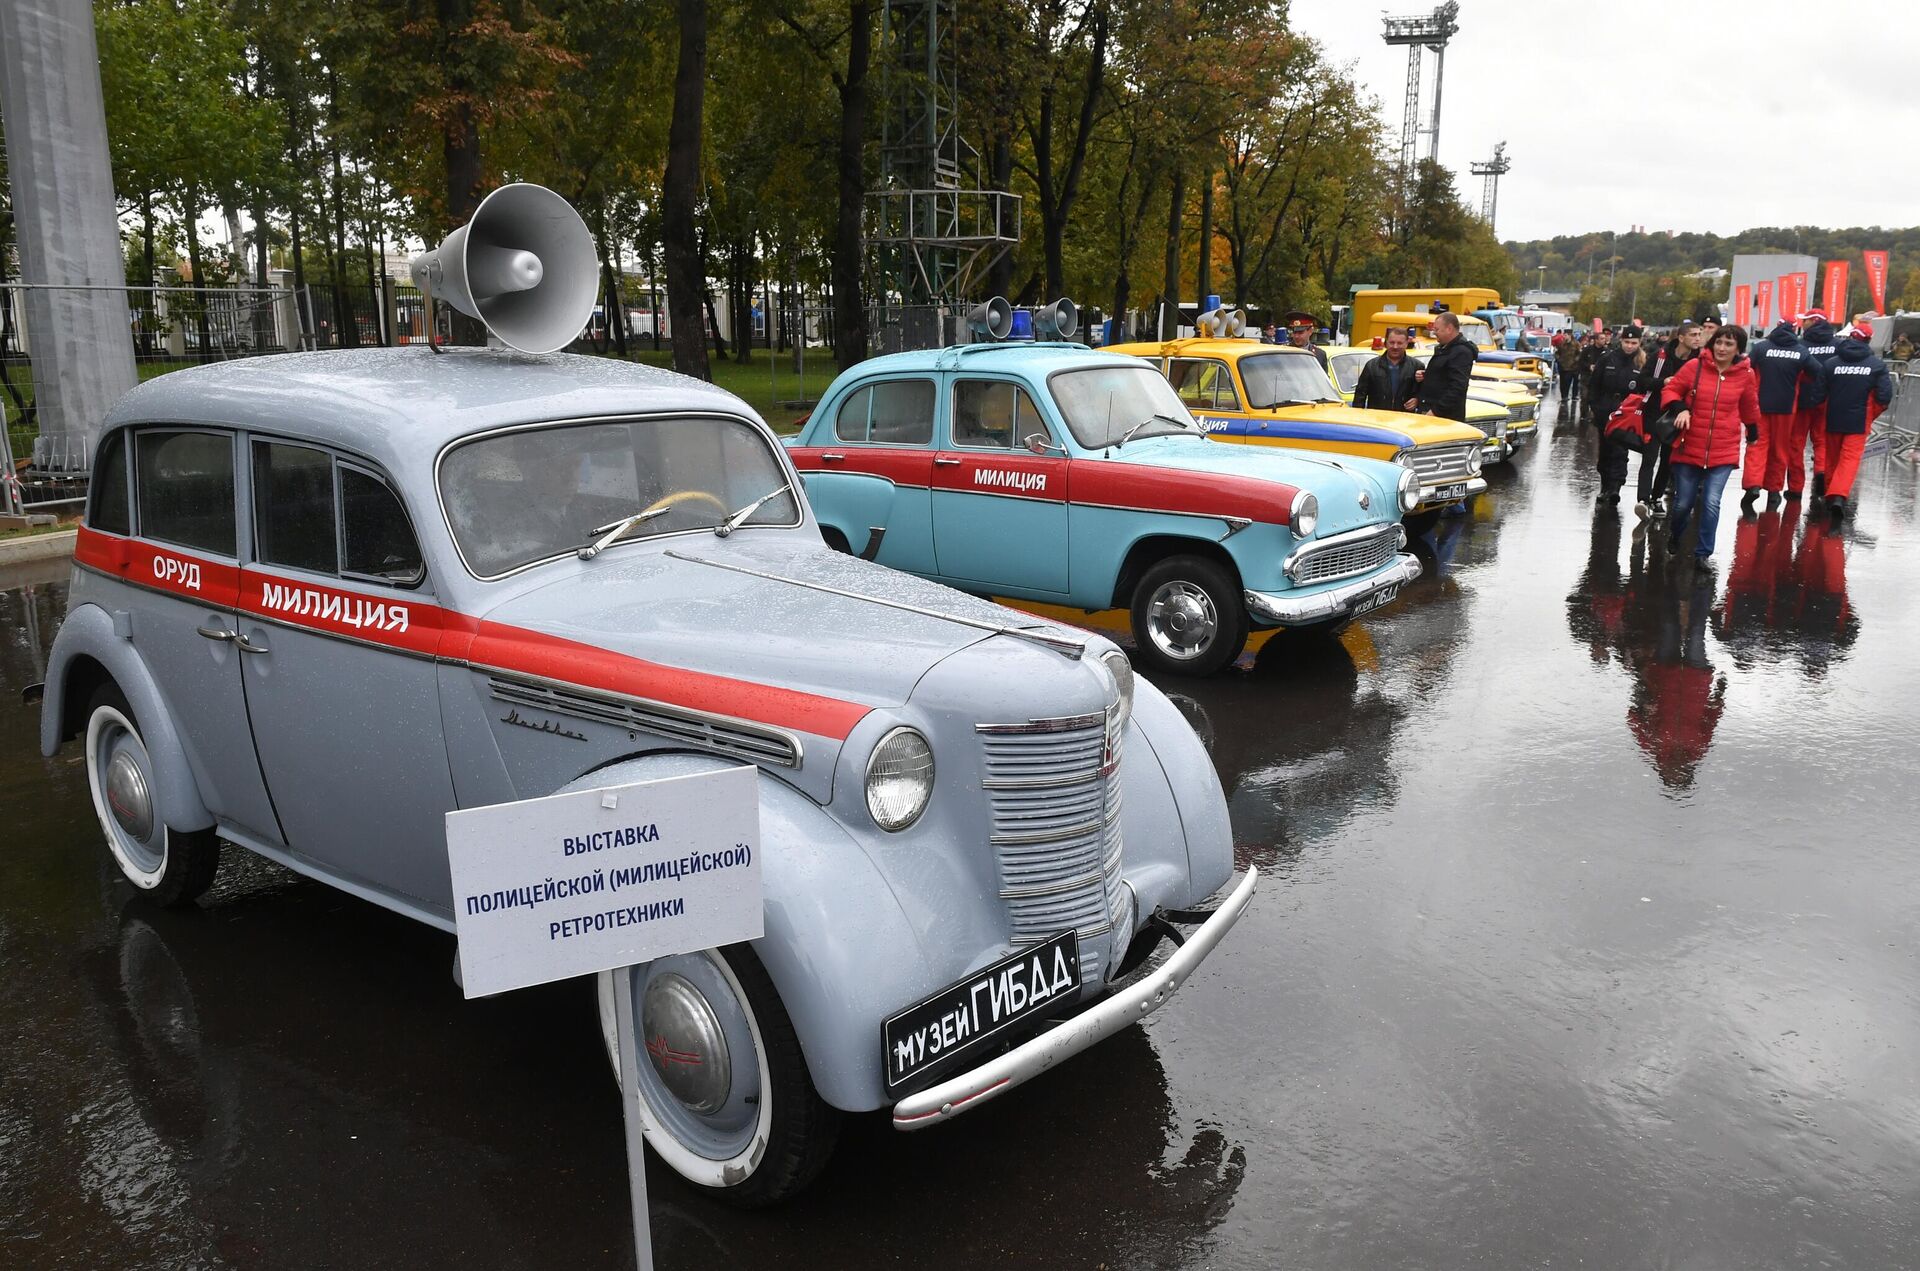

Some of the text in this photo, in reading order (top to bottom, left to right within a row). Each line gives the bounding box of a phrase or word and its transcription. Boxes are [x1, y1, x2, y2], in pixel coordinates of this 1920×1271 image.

[1766, 349, 1801, 360] RUSSIA
[1808, 345, 1836, 355] USSIA
[1834, 366, 1872, 375] RUSSIA
[974, 468, 1047, 492] МИЛИЦИЯ
[153, 555, 201, 591] ОРУД
[261, 582, 409, 633] МИЛИЦИЯ
[563, 823, 660, 857] ВЫСТАВКА
[466, 844, 752, 915] ПОЛИЦЕЙСКОЙ (МИЛИЦЕЙСКОЙ)
[550, 897, 685, 940] РЕТРОТЕХНИКИ
[898, 945, 1072, 1073] МУЗЕЙ ГИБДД
